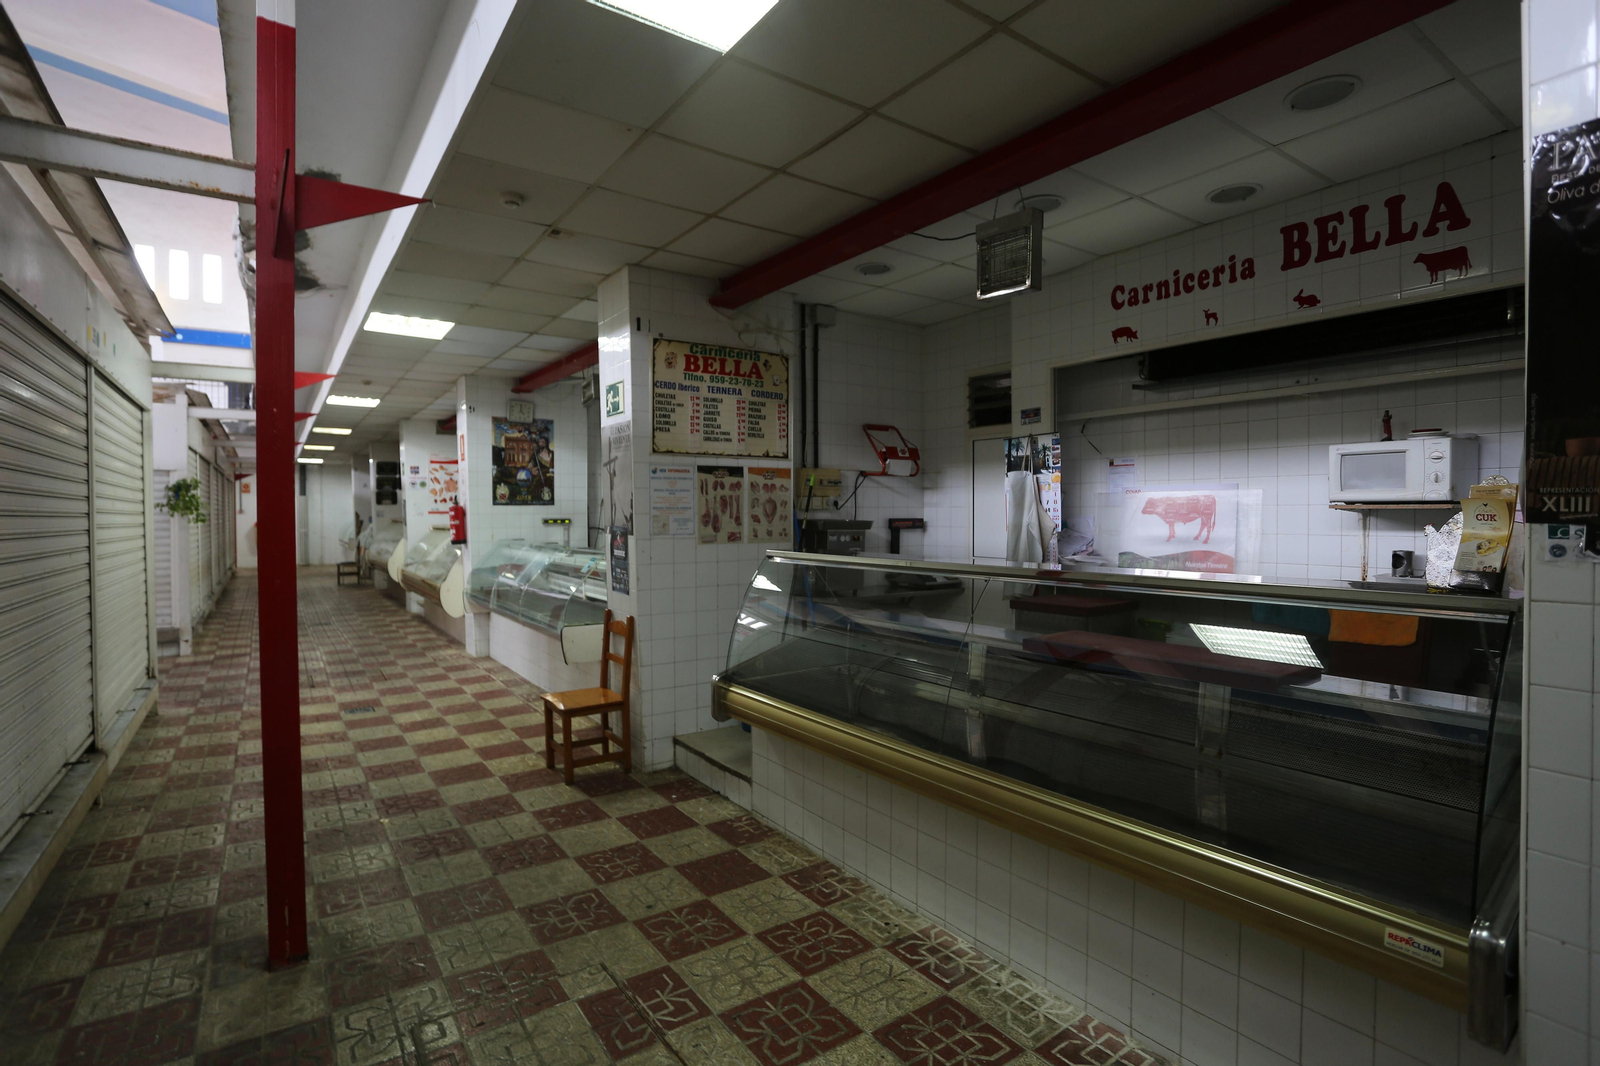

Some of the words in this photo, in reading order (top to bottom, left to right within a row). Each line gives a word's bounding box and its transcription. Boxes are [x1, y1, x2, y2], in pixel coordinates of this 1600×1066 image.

[1548, 186, 1584, 203] Oliva
[1111, 254, 1255, 310] Carniceria
[1280, 182, 1471, 271] BELLA
[683, 354, 764, 379] BELLA
[655, 380, 676, 390] CERDO
[683, 372, 706, 382] Tlfno.
[710, 375, 764, 388] 959-23-70-23
[707, 386, 742, 396] TERNERA
[751, 390, 784, 400] CORDERO
[1540, 485, 1600, 493] REPRESENTACIÓN
[1542, 496, 1590, 512] XLIII
[1476, 514, 1497, 522] CUK
